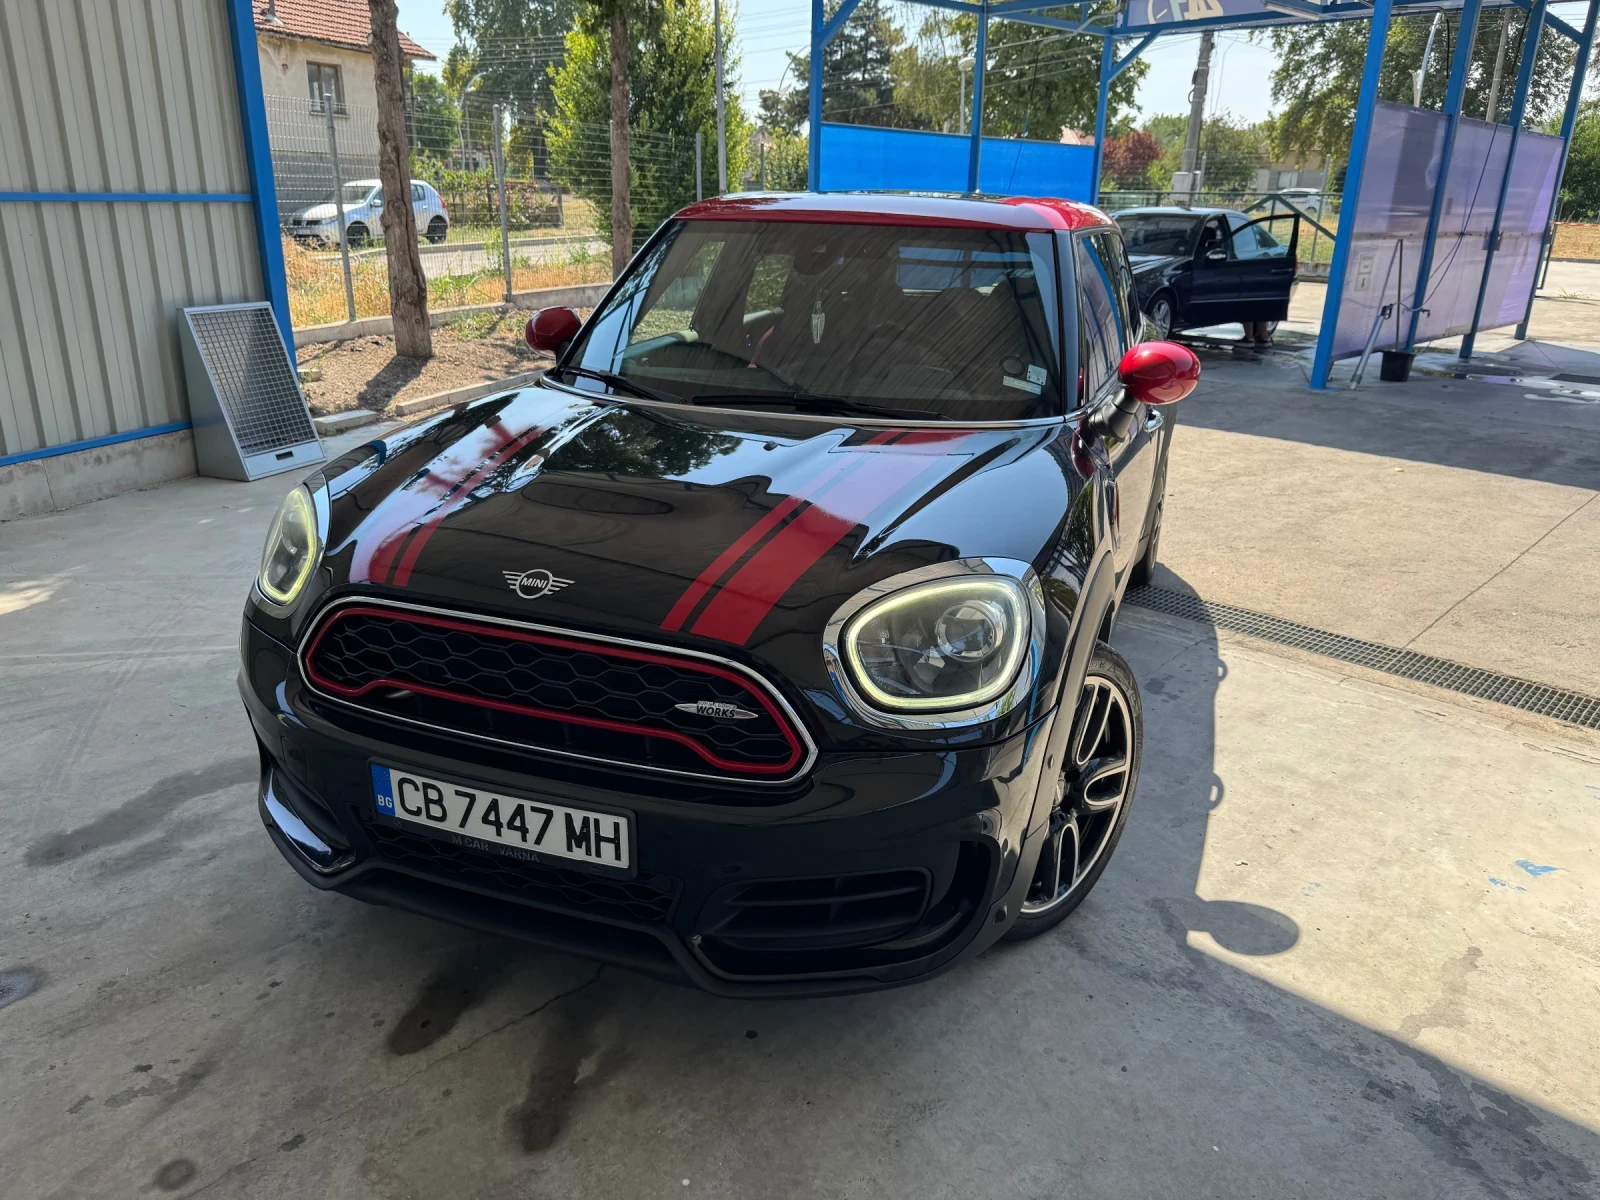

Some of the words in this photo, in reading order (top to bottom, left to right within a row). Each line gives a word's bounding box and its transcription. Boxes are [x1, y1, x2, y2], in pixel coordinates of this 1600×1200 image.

[521, 577, 548, 589] MINI
[696, 706, 736, 718] WORKS
[377, 794, 393, 809] BG
[397, 777, 448, 823] CB
[454, 789, 553, 846] 7447
[565, 812, 622, 861] MH
[464, 837, 489, 851] CAR
[499, 847, 540, 863] VARNA
